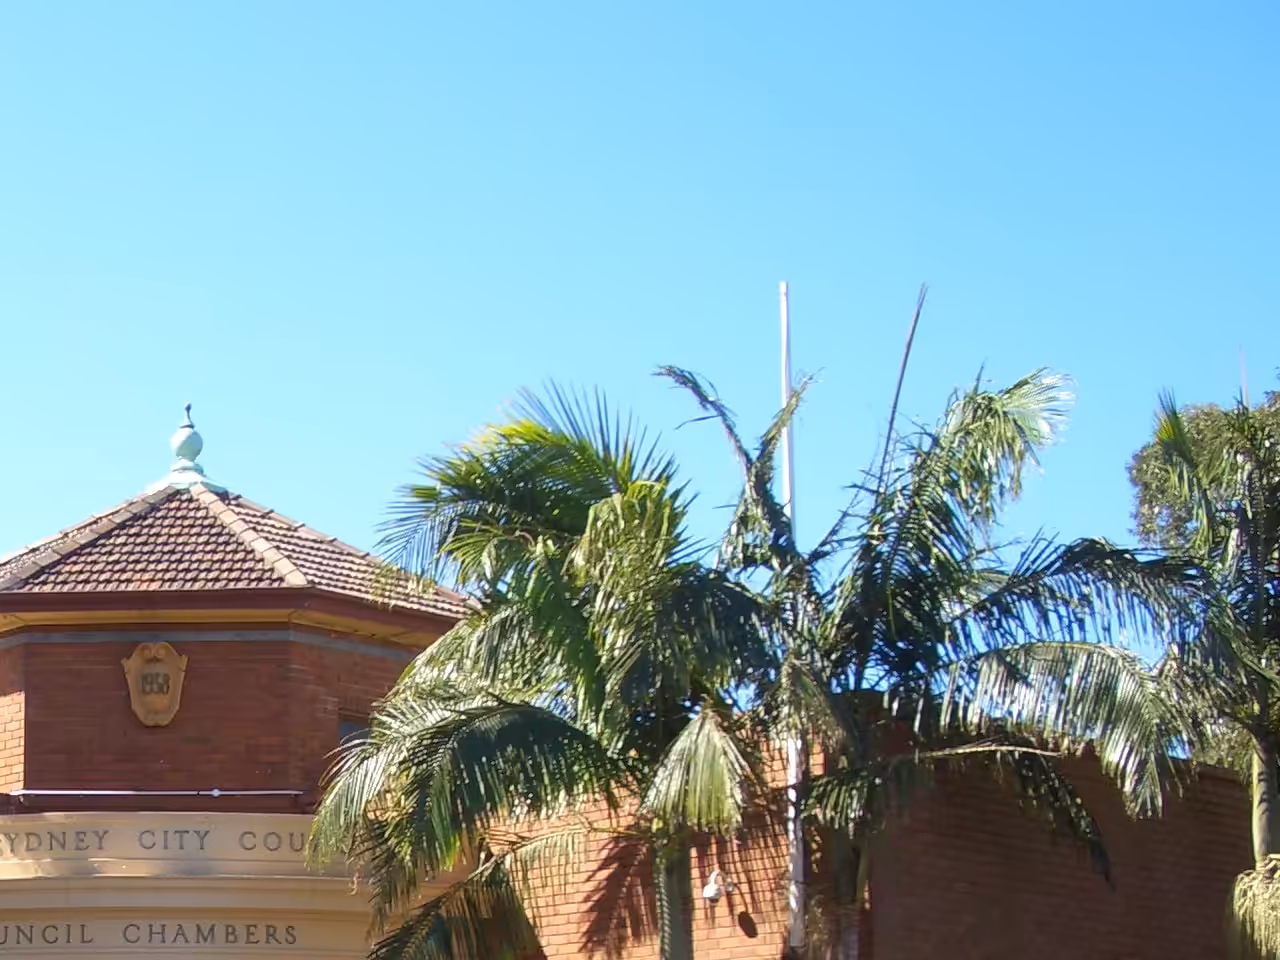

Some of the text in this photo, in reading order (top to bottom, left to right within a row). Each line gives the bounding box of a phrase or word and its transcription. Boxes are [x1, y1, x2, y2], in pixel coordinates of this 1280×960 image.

[138, 830, 210, 850] CITY
[239, 831, 306, 851] COU
[122, 923, 297, 945] CHAMBERS
